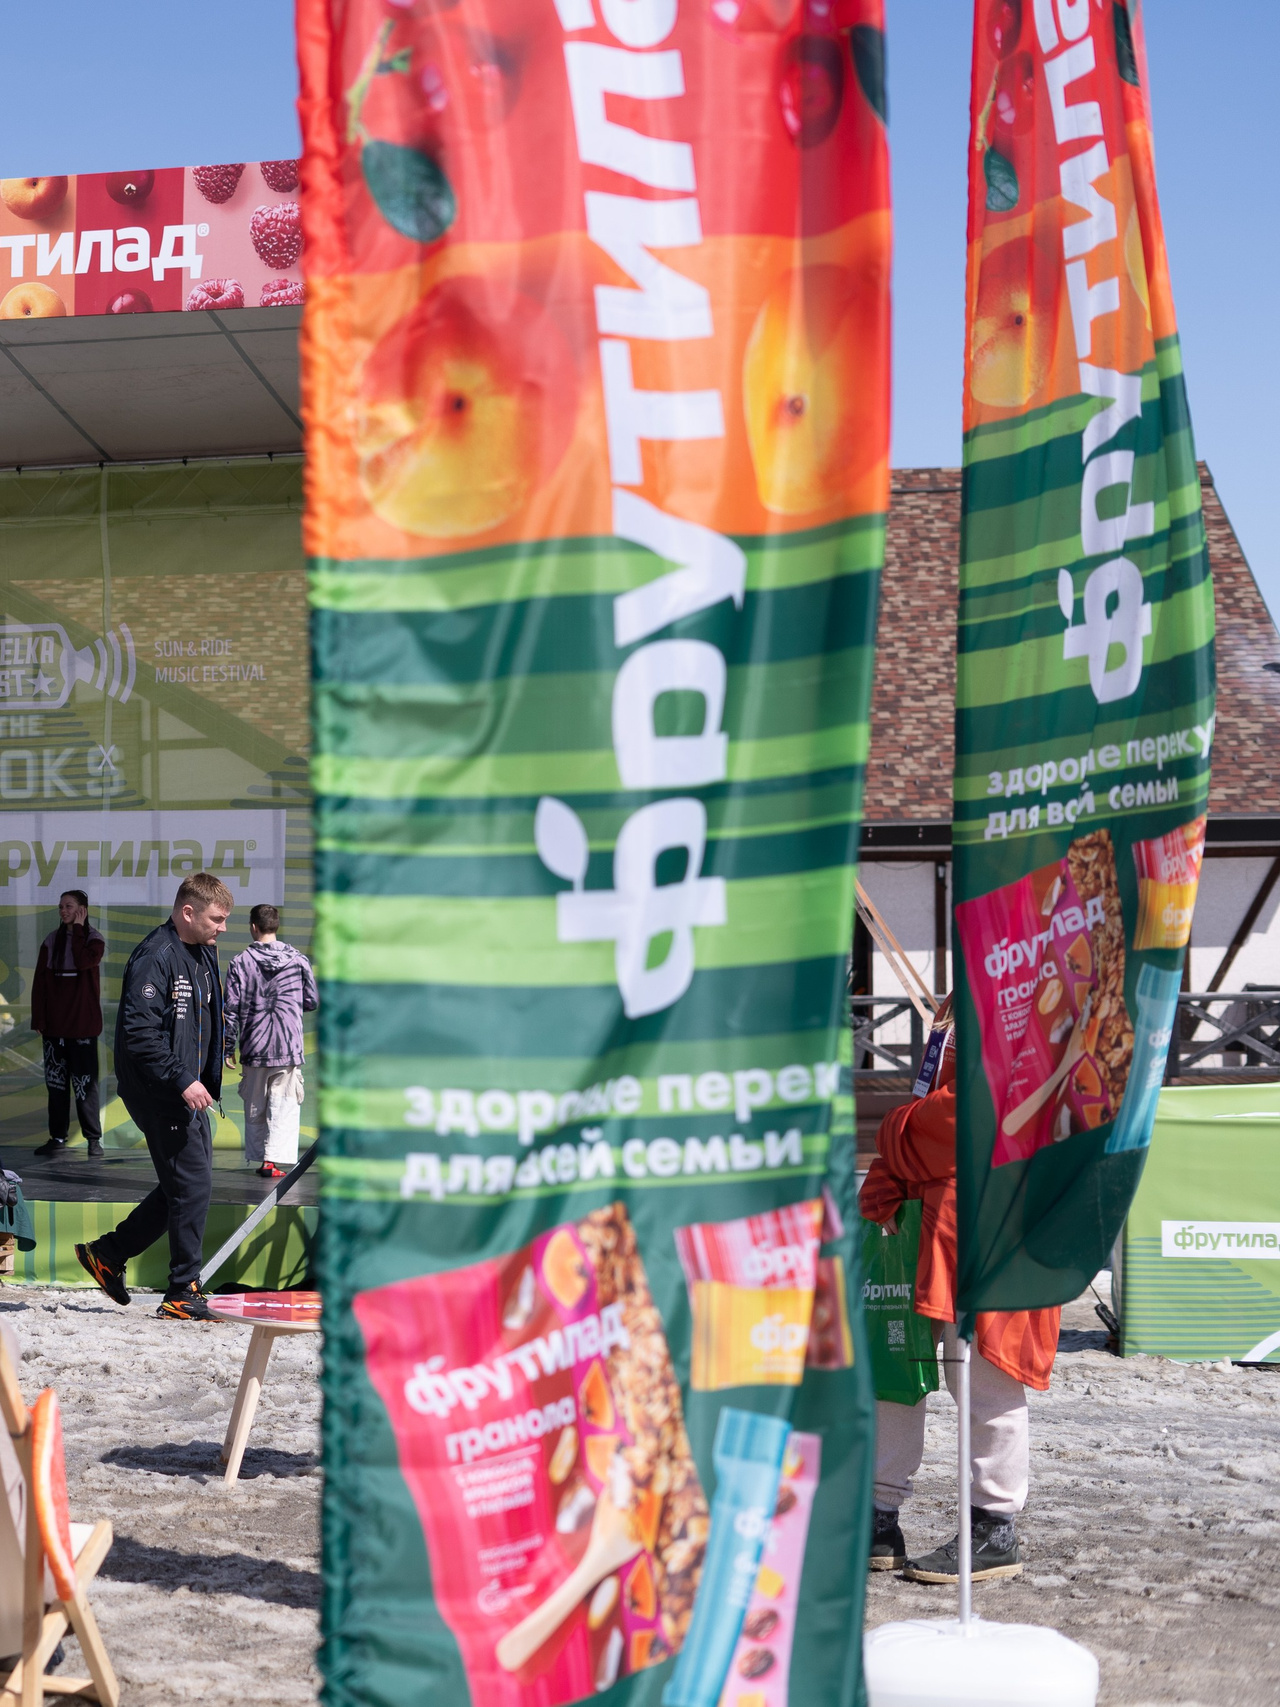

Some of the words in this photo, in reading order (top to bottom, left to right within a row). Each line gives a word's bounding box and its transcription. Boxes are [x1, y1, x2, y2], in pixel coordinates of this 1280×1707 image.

[154, 640, 184, 658] SUN
[187, 640, 198, 657] &
[201, 638, 233, 656] RIDE
[154, 665, 199, 684] MUSIC
[202, 663, 267, 682] FESTIVAL
[984, 805, 1040, 841] для
[1107, 777, 1179, 810] семьи
[400, 1152, 516, 1201] для
[622, 1129, 803, 1178] семьи
[1174, 1225, 1280, 1251] фрутила
